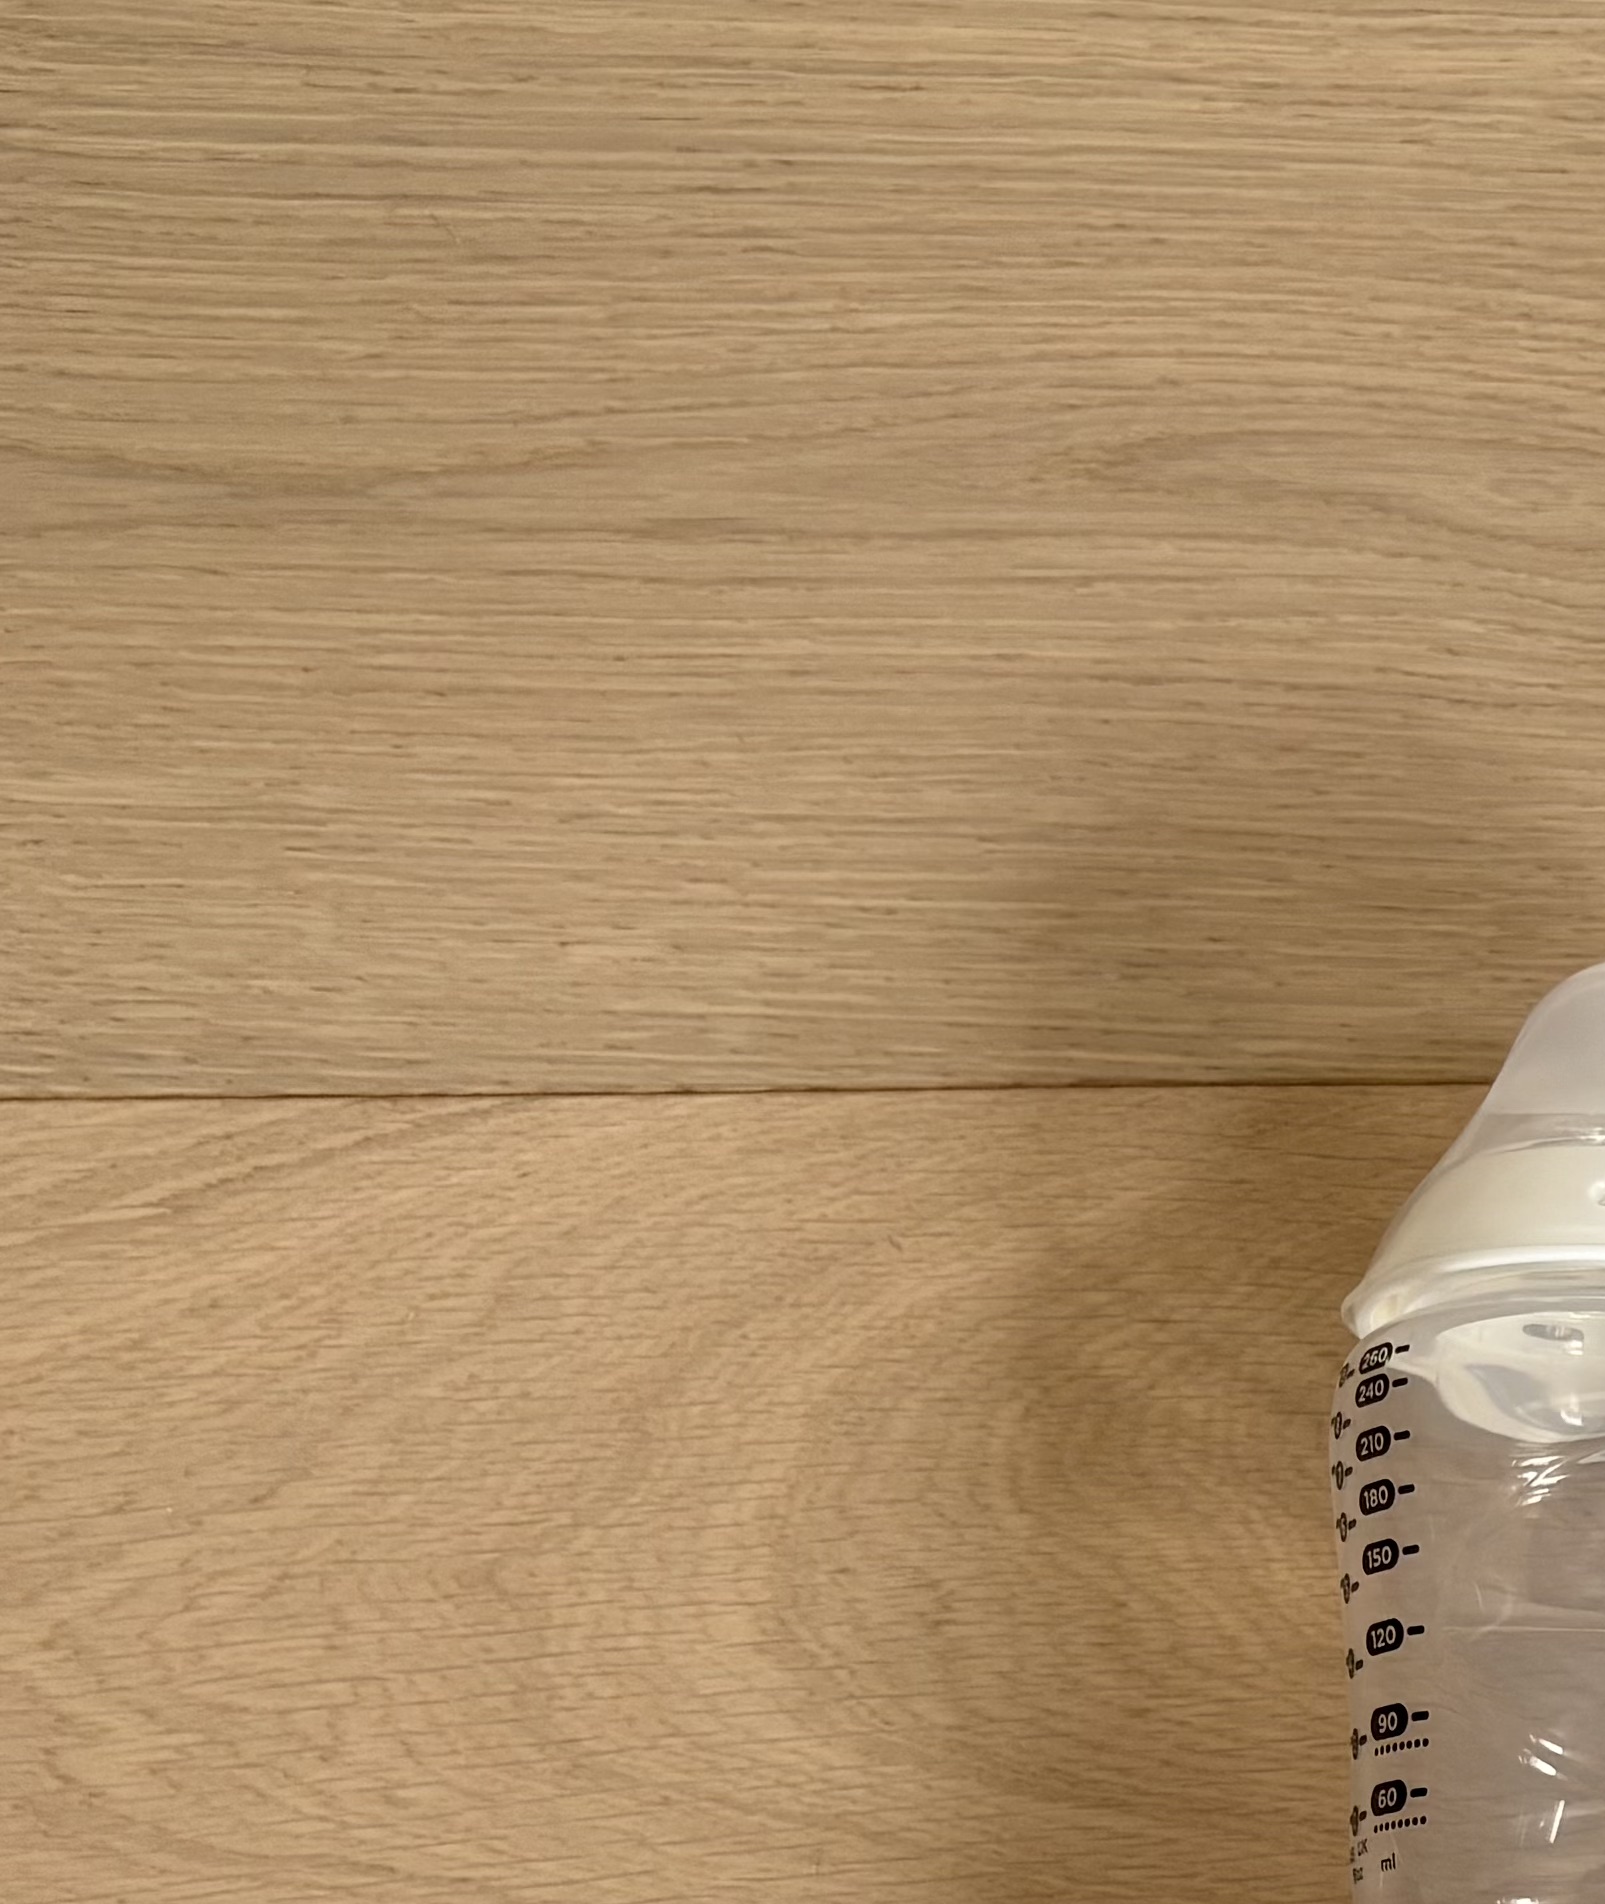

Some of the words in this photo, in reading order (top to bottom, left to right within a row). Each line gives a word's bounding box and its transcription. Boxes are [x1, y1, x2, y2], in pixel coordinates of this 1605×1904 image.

[1361, 1347, 1388, 1370] 260
[1358, 1379, 1385, 1403] 240
[1360, 1432, 1384, 1456] 210
[1363, 1485, 1389, 1510] 180
[1367, 1545, 1392, 1570] 150
[1371, 1625, 1396, 1649] 120
[1378, 1711, 1398, 1734] 90
[1378, 1787, 1398, 1809] 60
[1381, 1852, 1396, 1872] ml
